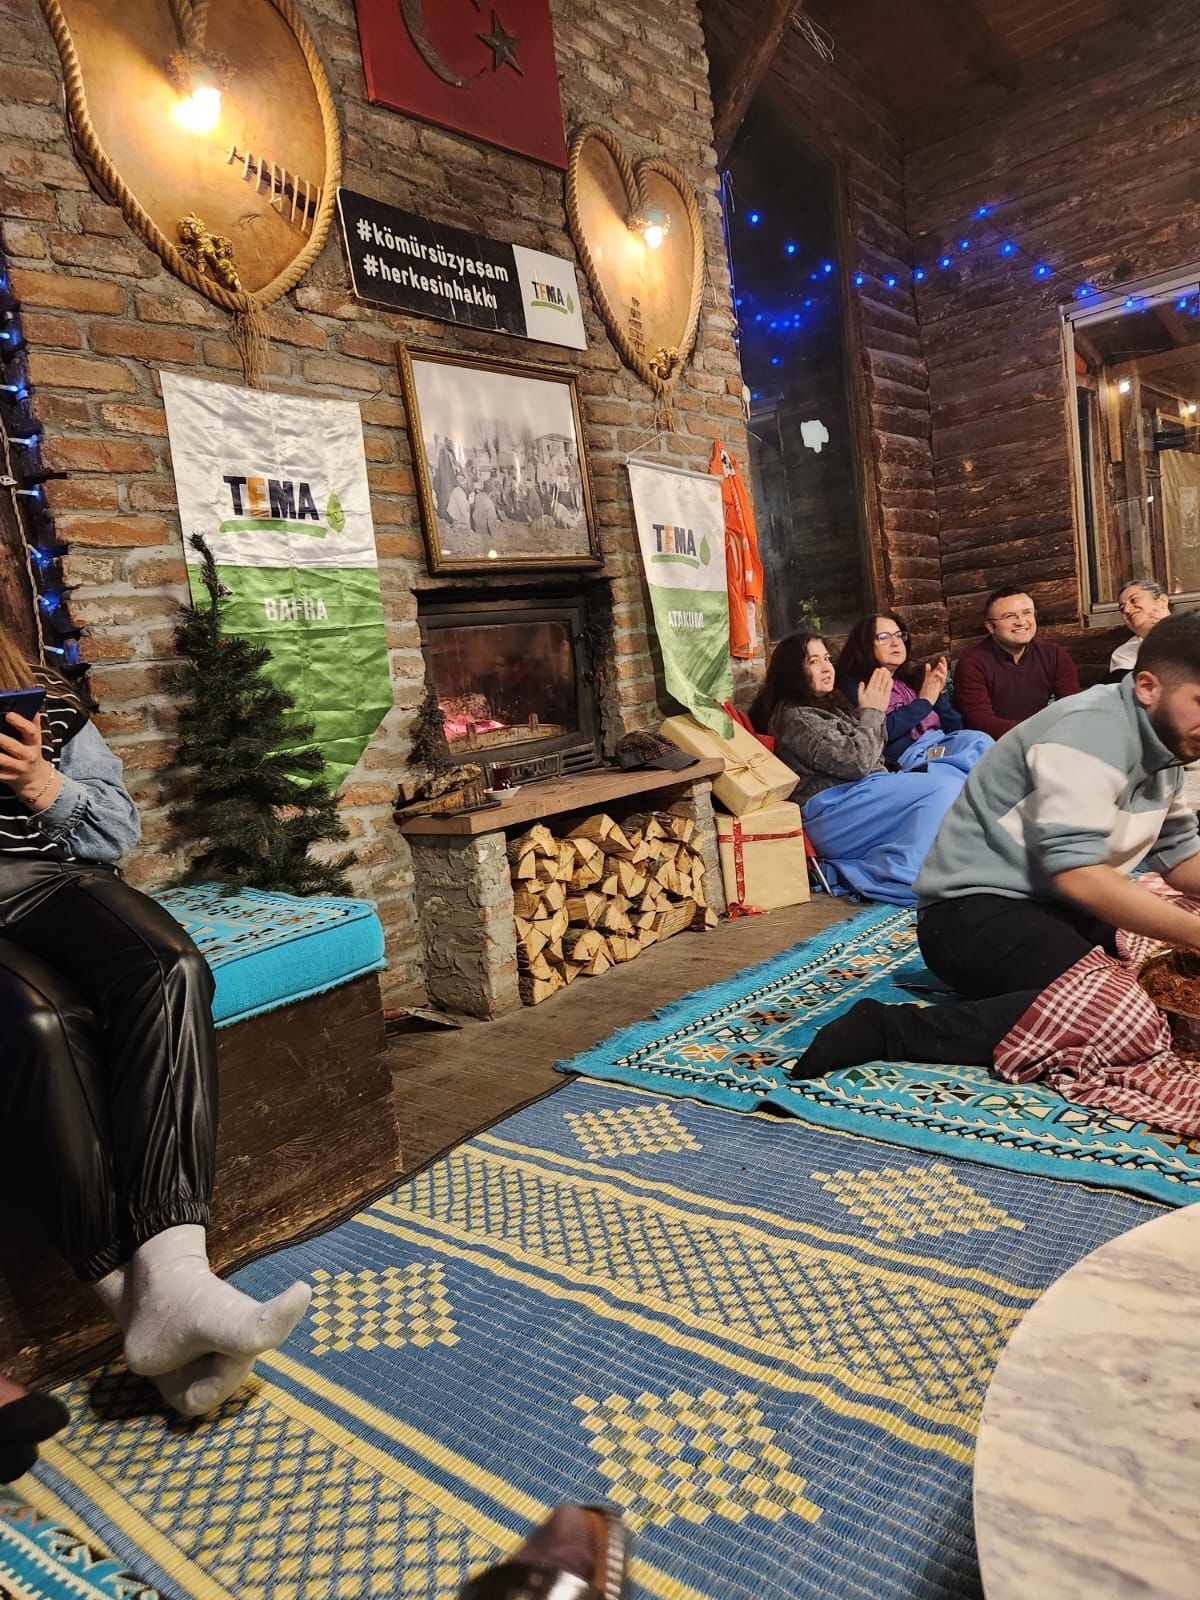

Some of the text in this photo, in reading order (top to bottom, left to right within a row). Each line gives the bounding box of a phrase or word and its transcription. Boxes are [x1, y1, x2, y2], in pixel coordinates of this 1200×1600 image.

[356, 217, 509, 283] #kömürsüzyaşam
[363, 253, 498, 310] #herkesinhakkı
[531, 280, 565, 306] TEMA
[223, 475, 320, 520] TEMA
[652, 523, 697, 556] TEMA
[264, 596, 329, 621] BAFRA
[668, 610, 704, 628] ATAKUM
